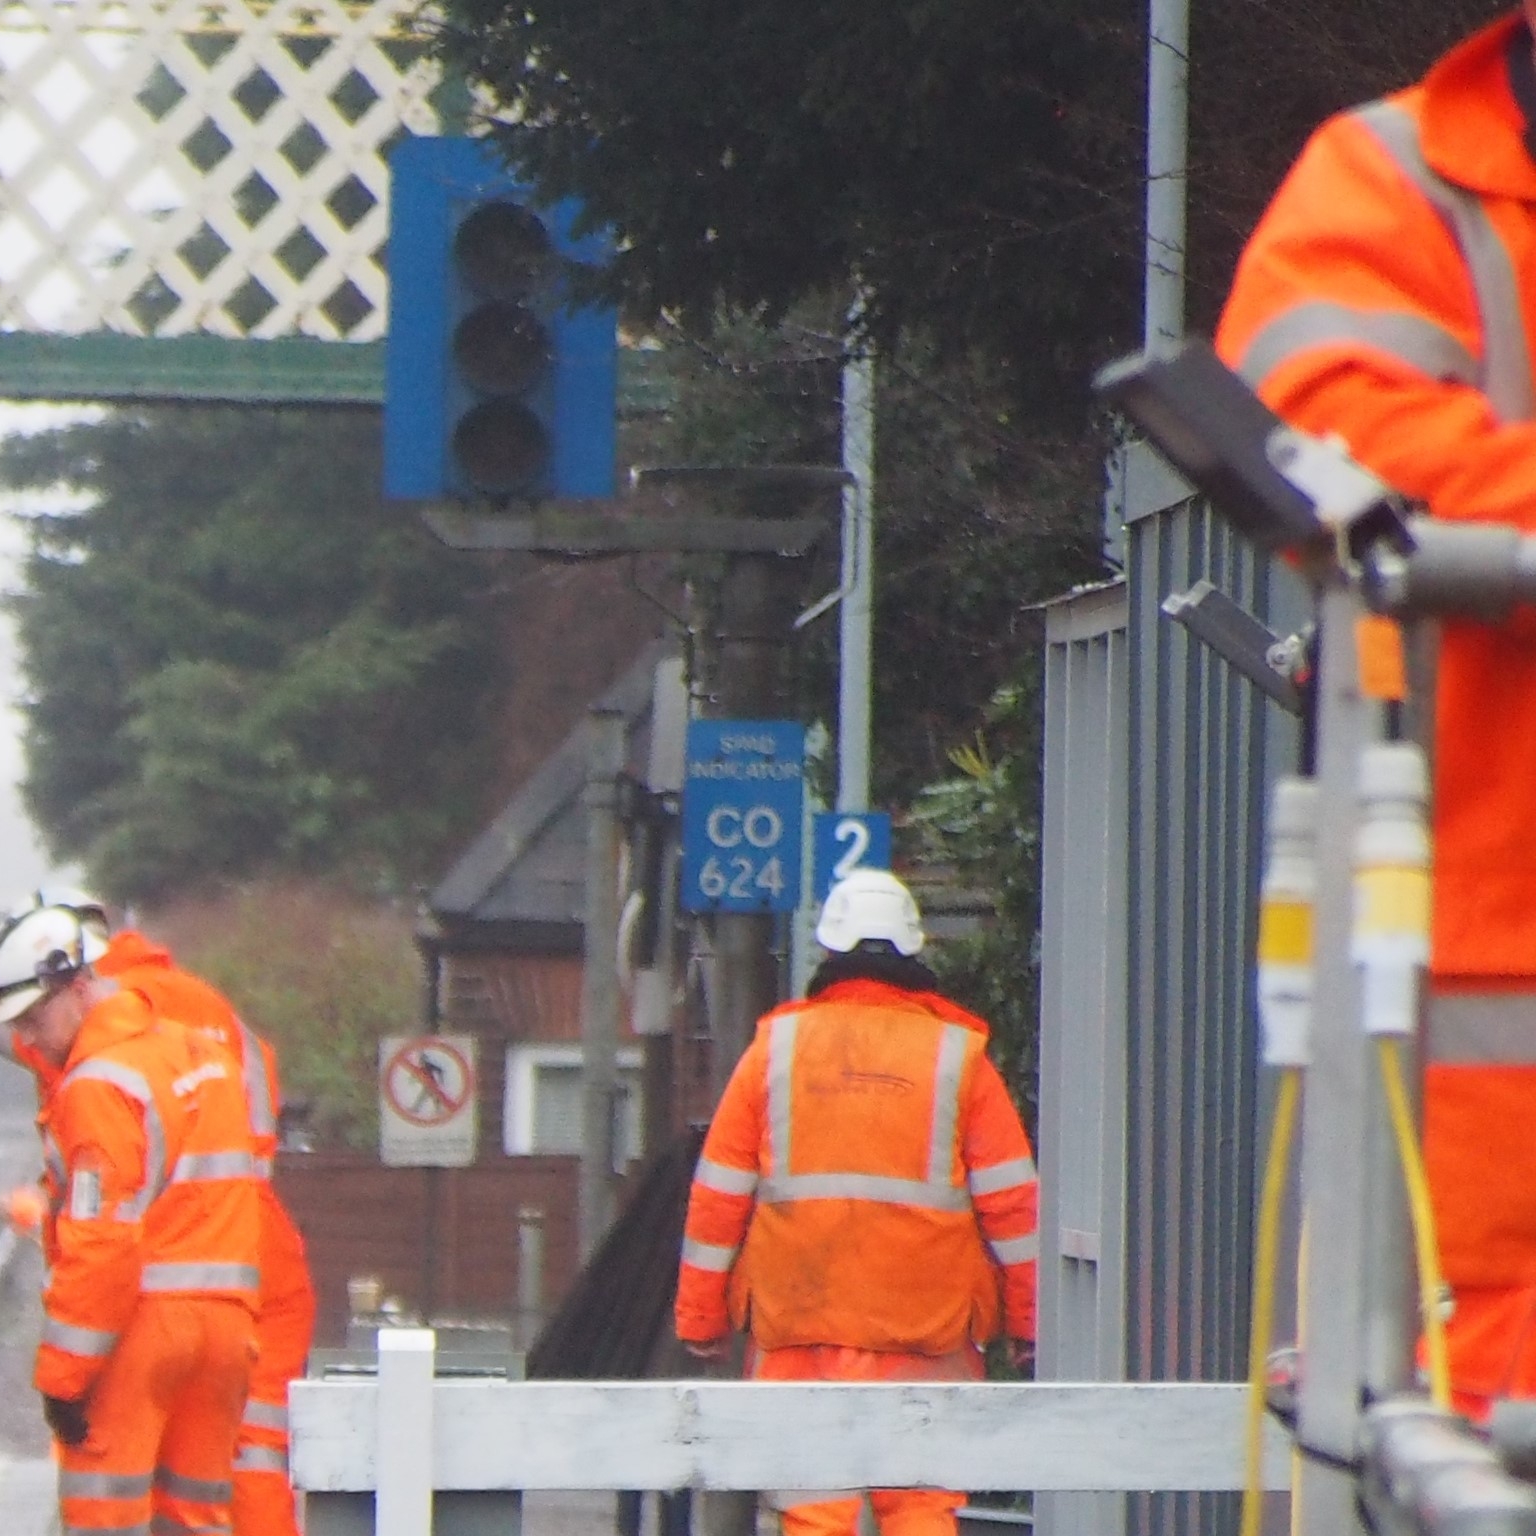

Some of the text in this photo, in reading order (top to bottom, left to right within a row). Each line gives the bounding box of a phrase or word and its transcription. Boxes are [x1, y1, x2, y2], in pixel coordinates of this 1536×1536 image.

[705, 806, 784, 848] CO
[833, 819, 871, 879] 2
[698, 857, 785, 899] 624
